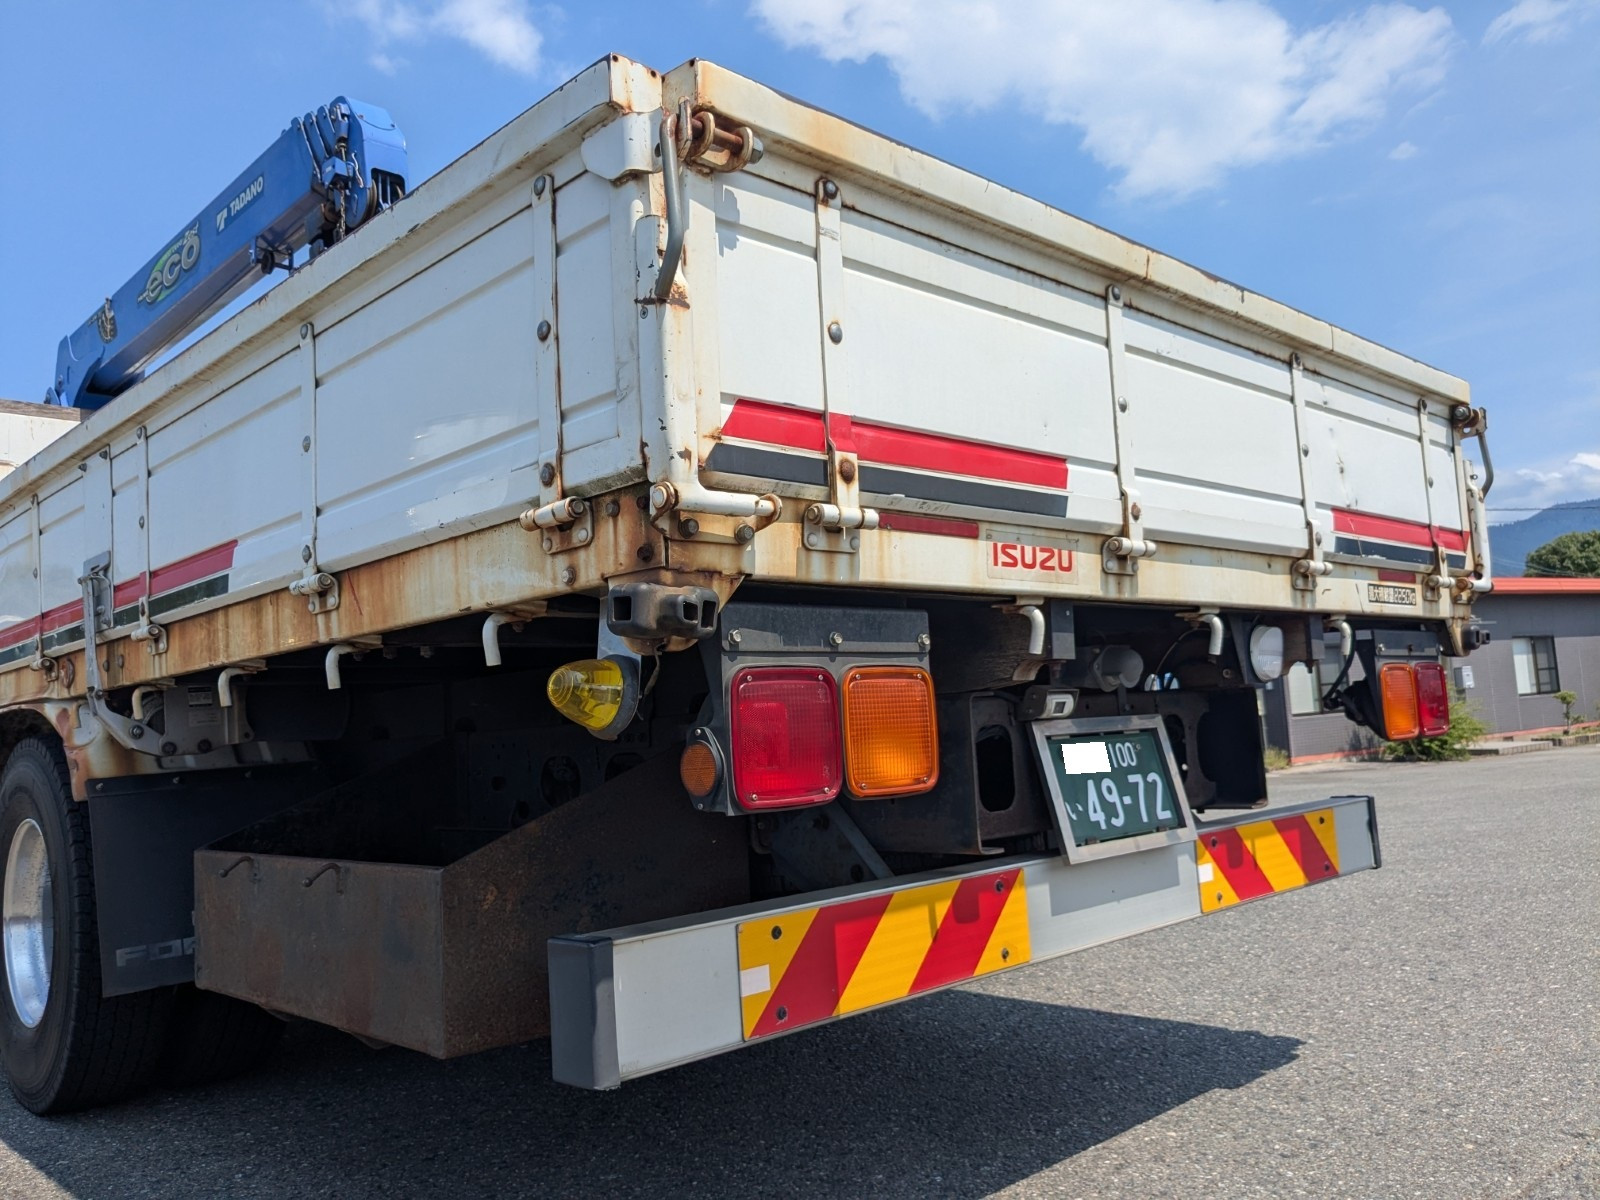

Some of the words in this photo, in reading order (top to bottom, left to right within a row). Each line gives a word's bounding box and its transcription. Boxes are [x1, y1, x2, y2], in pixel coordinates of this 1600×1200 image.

[229, 176, 264, 217] TADANO
[146, 236, 201, 304] eco
[993, 543, 1073, 572] ISUZU
[1108, 742, 1137, 768] 100
[1087, 772, 1173, 830] 49-72
